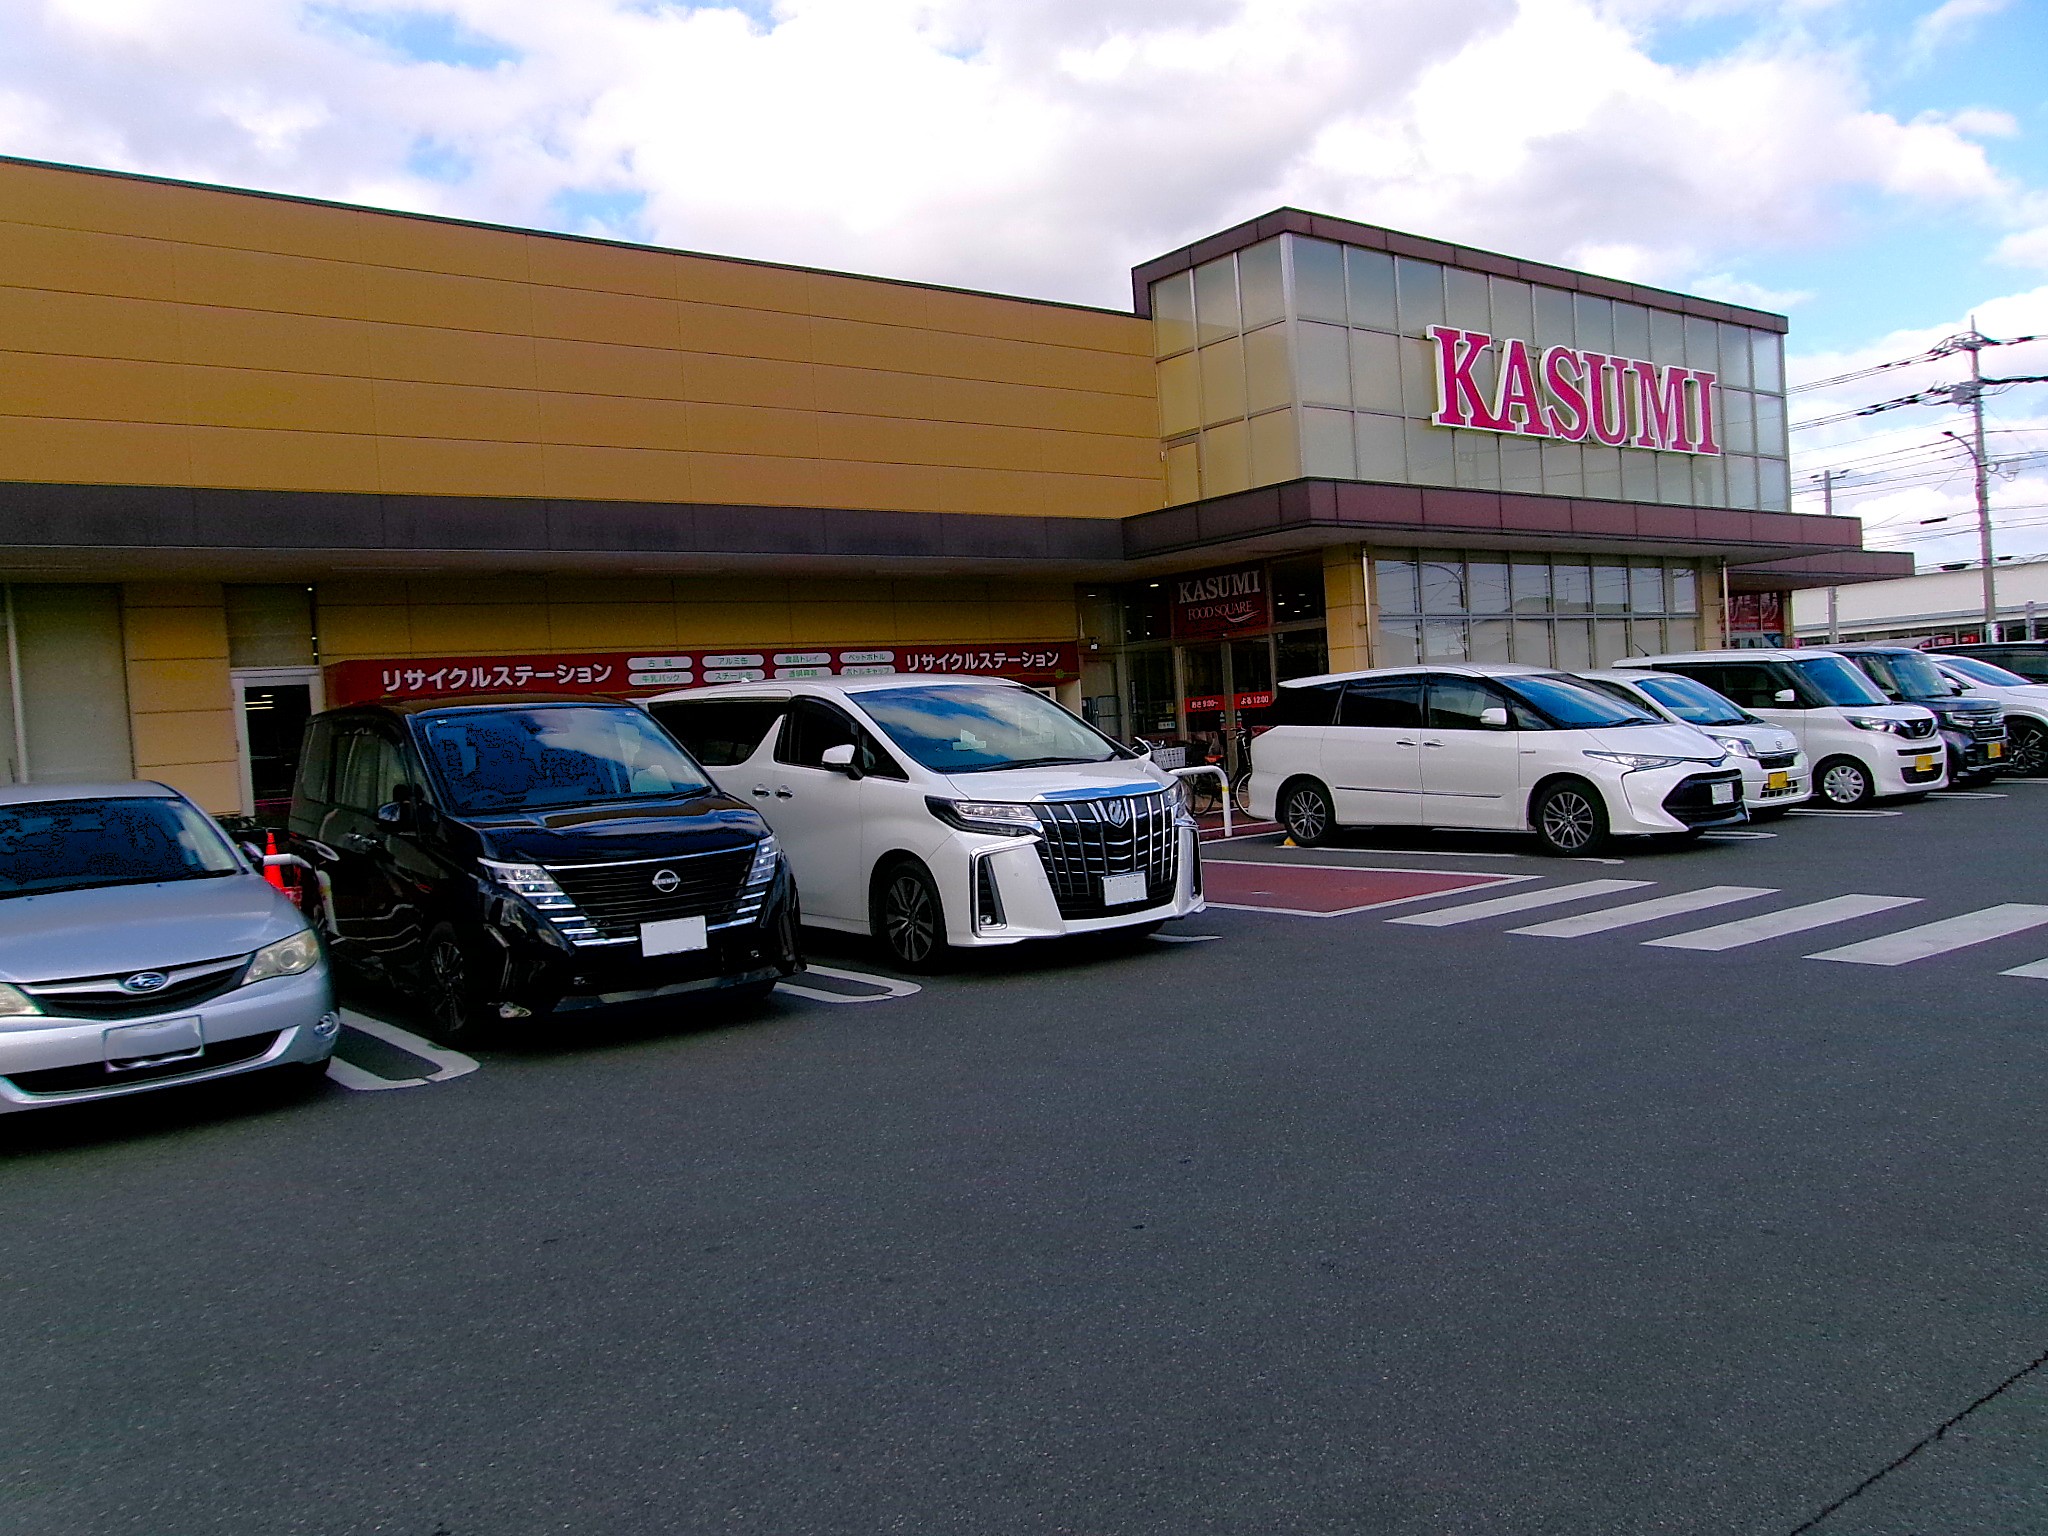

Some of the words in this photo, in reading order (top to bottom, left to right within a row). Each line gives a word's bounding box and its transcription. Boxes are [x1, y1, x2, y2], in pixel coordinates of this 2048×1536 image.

[1426, 324, 1721, 456] KASUMI
[1178, 570, 1260, 604] KASUMI
[1188, 607, 1213, 620] FOOD
[1215, 601, 1253, 617] SQUARE
[718, 657, 749, 665] アルミ缶
[785, 655, 819, 664] 食品トレイ
[848, 653, 886, 661] ペットボトル
[907, 652, 1059, 671] リサイクルステーション
[382, 664, 612, 691] リサイクルステーション
[642, 674, 680, 683] 牛乳パック
